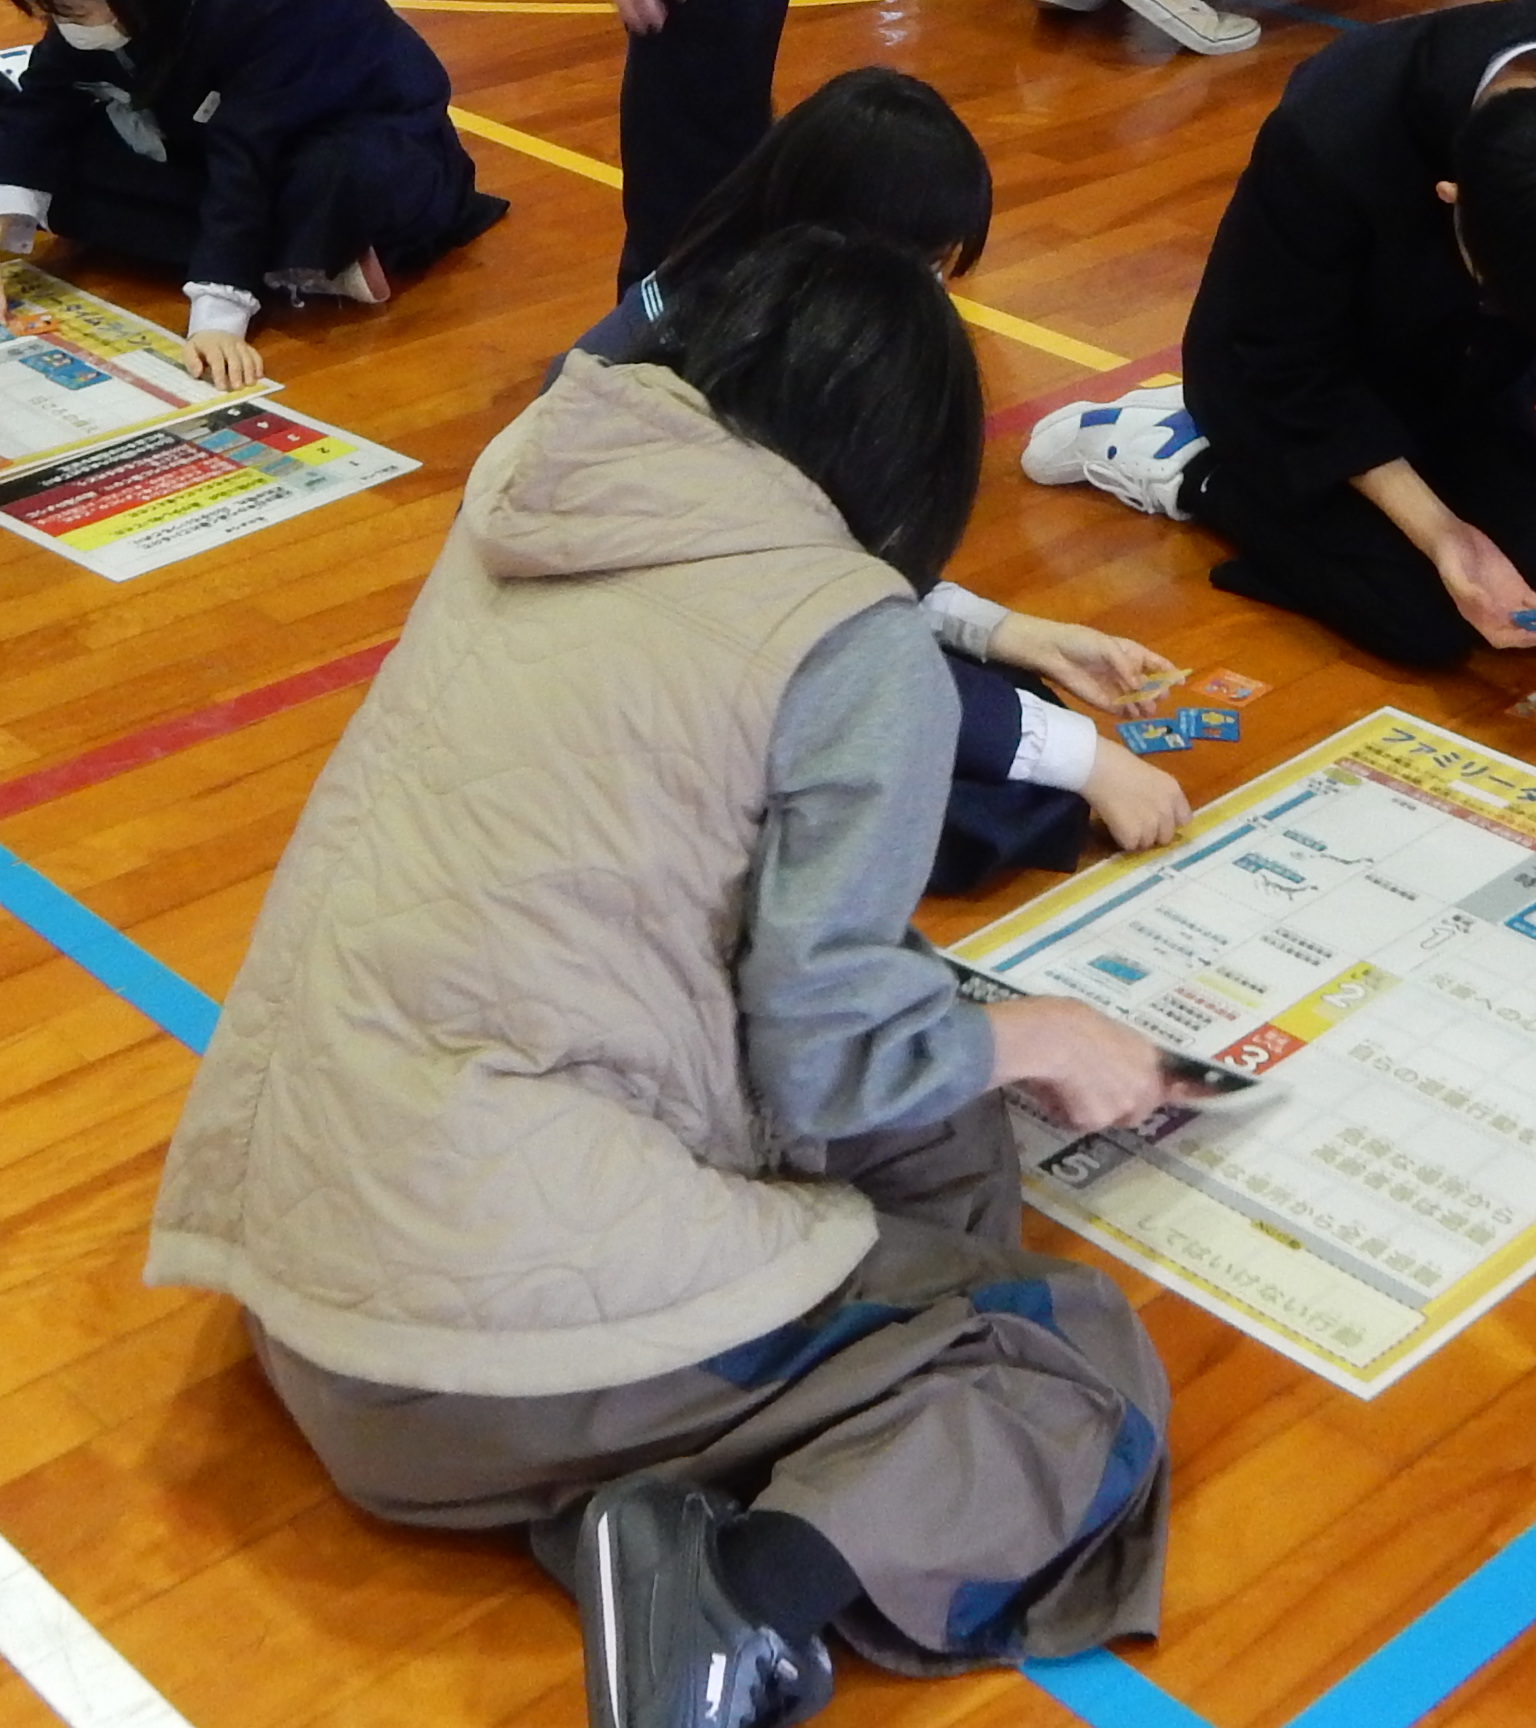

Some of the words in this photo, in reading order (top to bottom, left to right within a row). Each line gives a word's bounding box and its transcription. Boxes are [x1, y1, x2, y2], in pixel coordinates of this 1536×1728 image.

[1321, 982, 1366, 1009] 2
[1224, 1044, 1271, 1073] 3
[1051, 1153, 1100, 1183] 5
